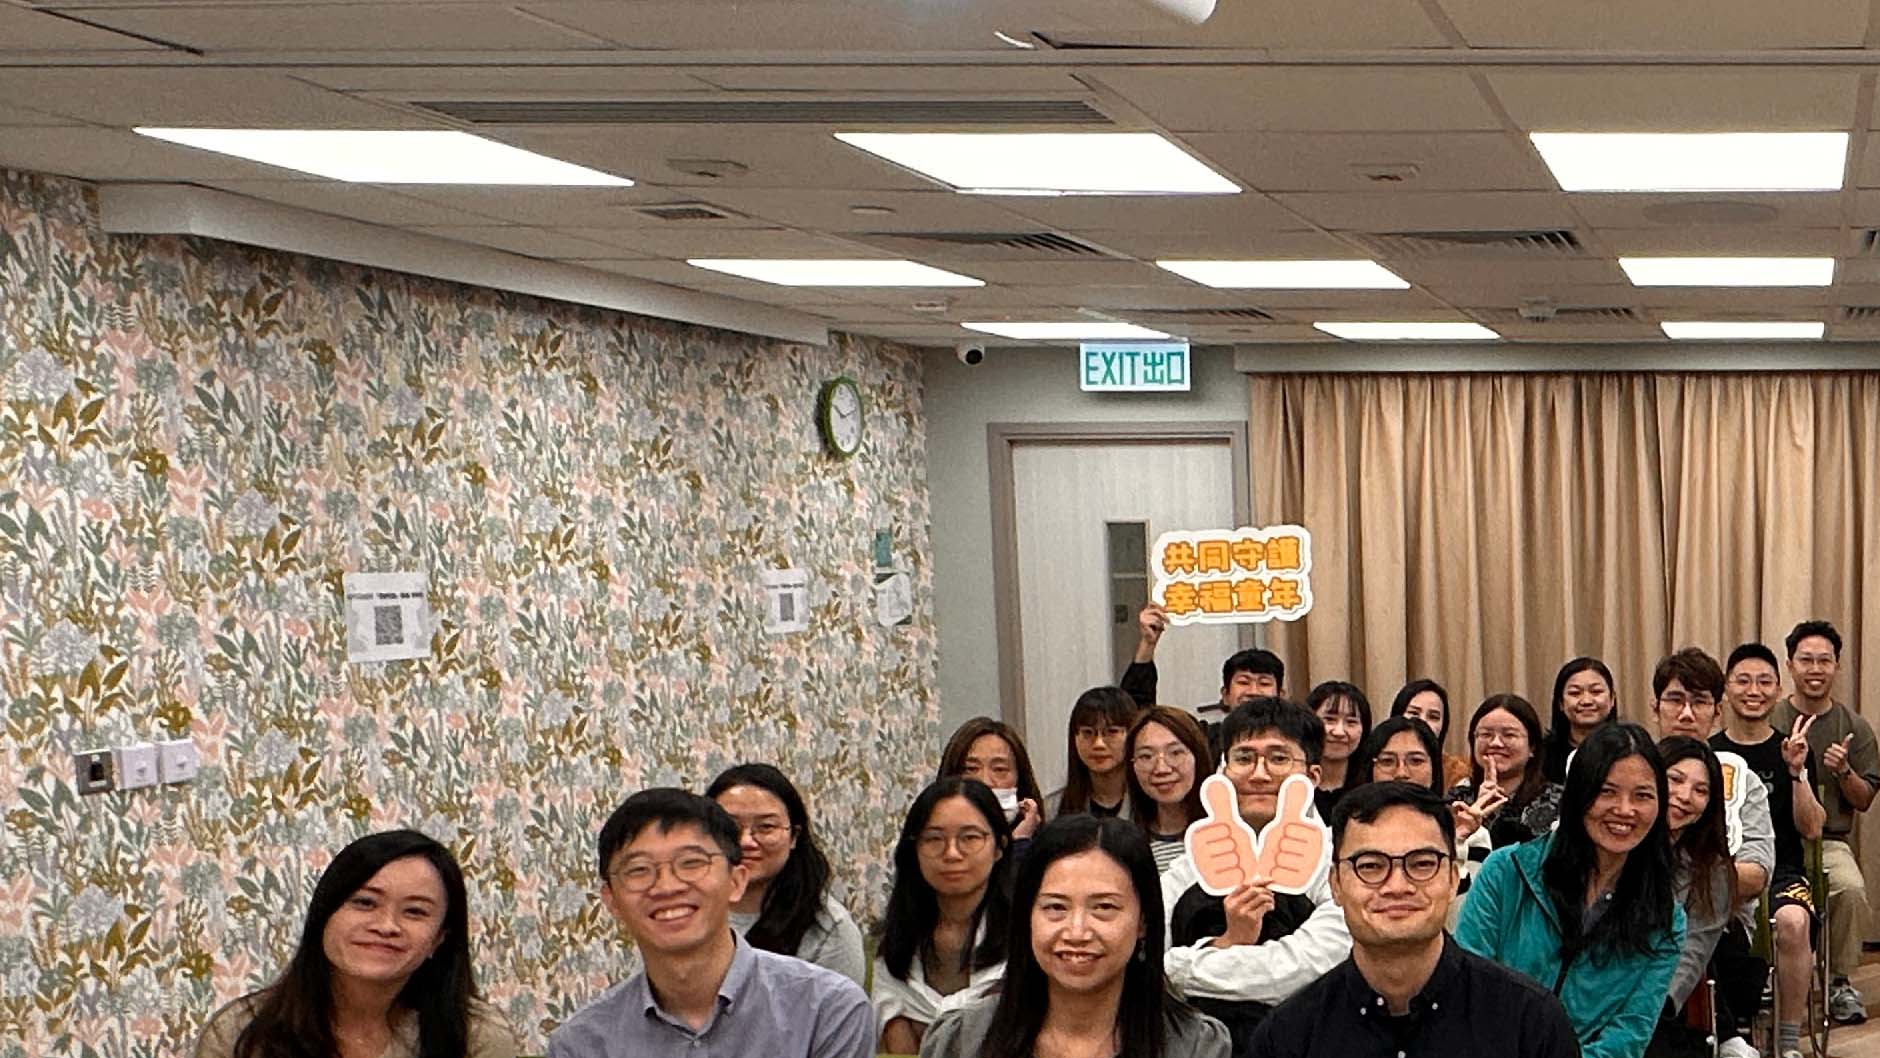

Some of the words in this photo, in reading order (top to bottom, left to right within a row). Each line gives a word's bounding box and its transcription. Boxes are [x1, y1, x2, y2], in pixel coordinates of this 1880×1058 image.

[1085, 351, 1141, 386] EXIT
[1143, 351, 1185, 385] 出口
[1162, 535, 1301, 575] 共同守護
[1163, 577, 1303, 615] 幸福童年
